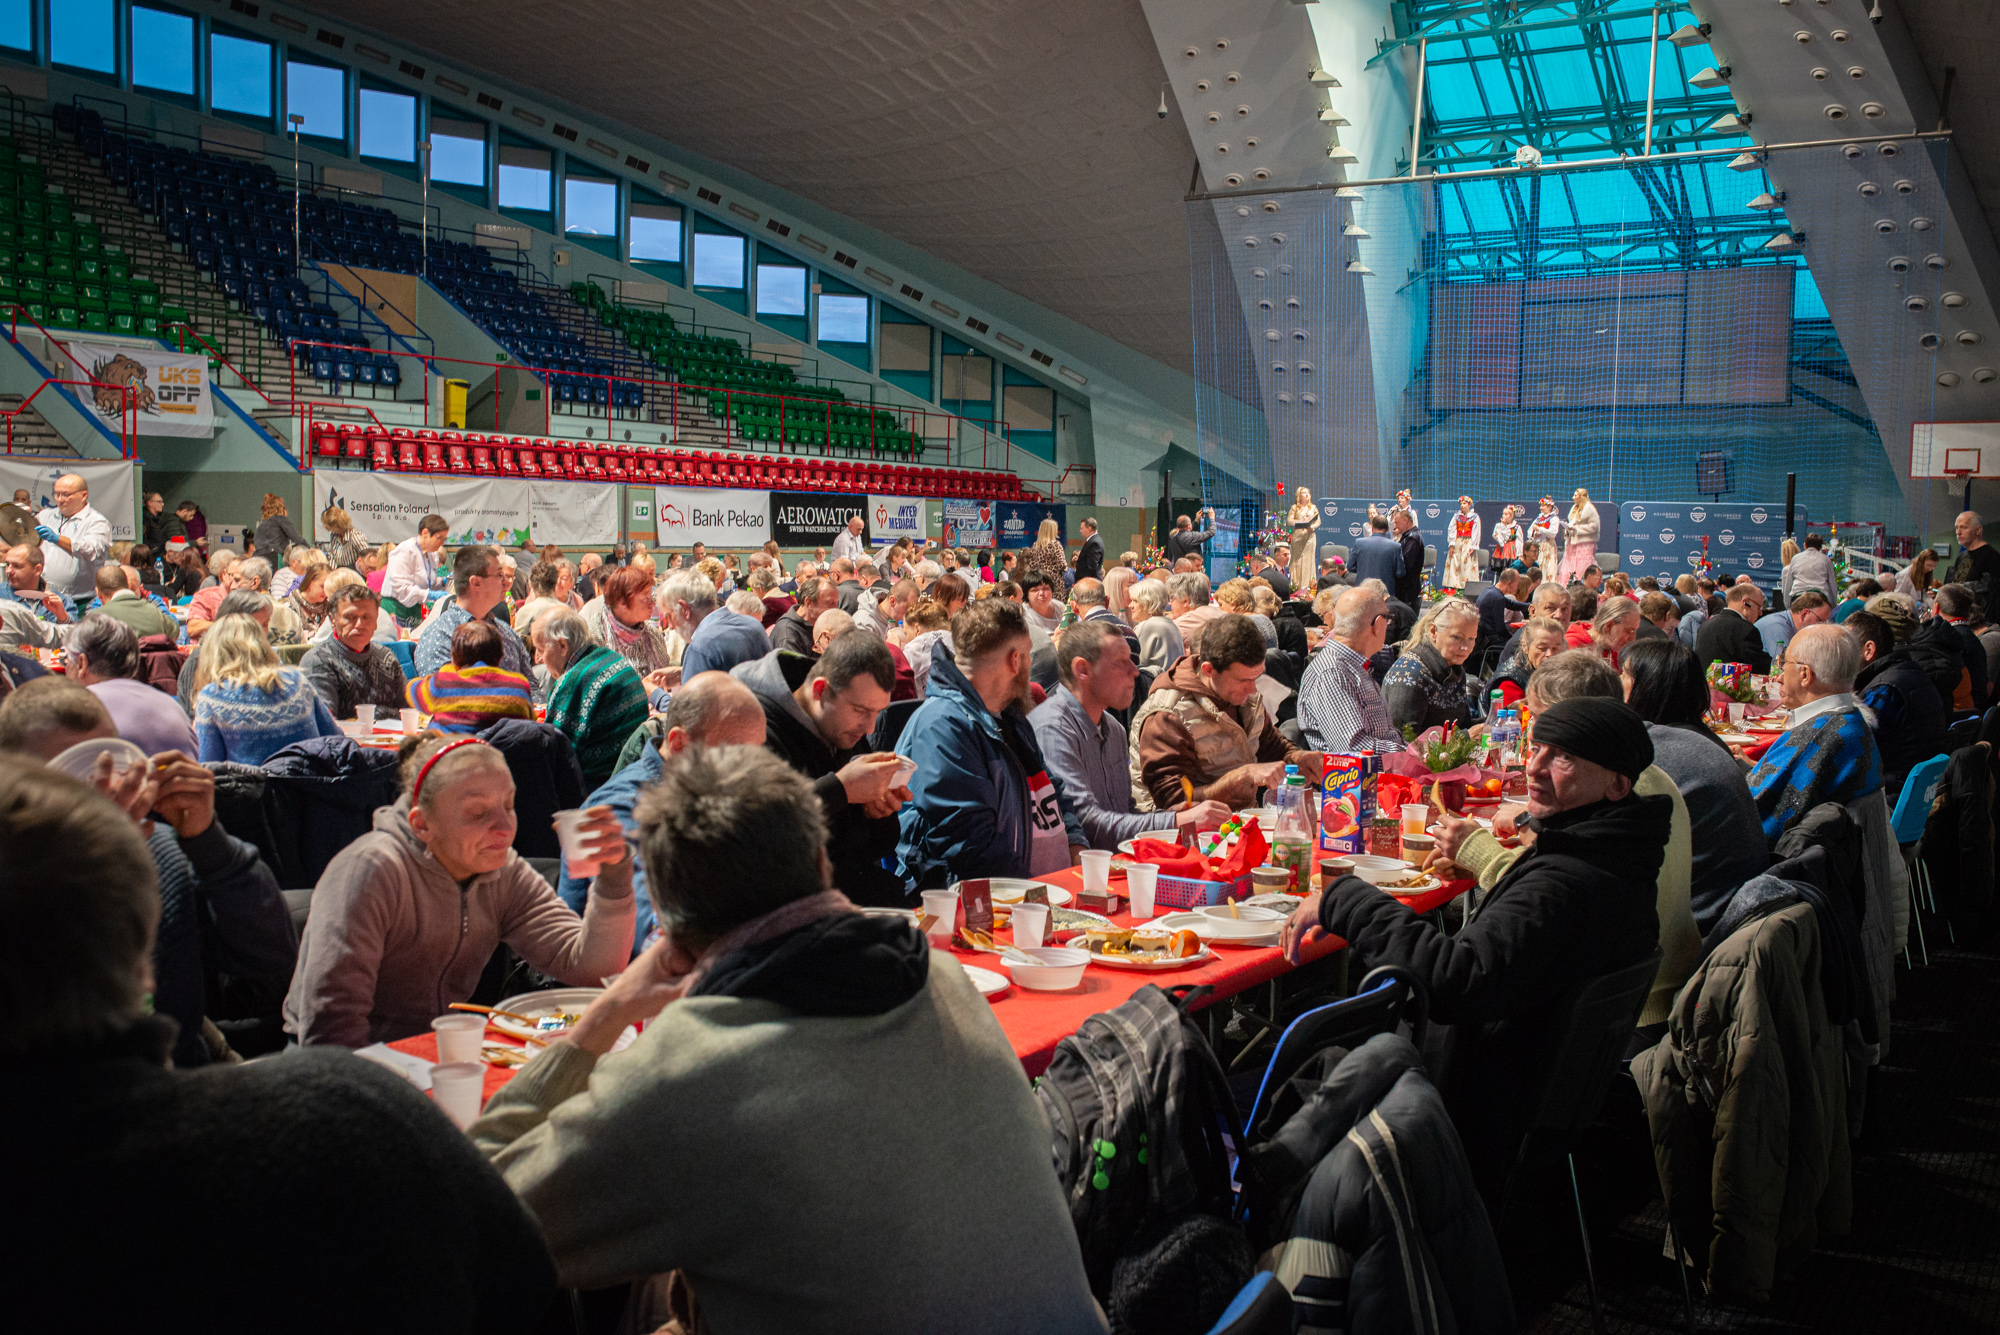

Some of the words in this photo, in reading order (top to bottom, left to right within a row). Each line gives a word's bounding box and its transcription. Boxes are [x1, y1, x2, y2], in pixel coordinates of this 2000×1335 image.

[158, 366, 202, 385] UKS
[158, 385, 201, 403] OPP
[350, 501, 396, 513] Sensation
[398, 503, 430, 515] Poland
[1120, 497, 1127, 506] D
[455, 508, 480, 517] produkty
[898, 505, 917, 518] INTER
[693, 509, 725, 527] Bank
[728, 509, 764, 528] Pekao
[889, 517, 917, 530] MEDICAL
[1326, 755, 1333, 766] 2
[1324, 767, 1359, 791] Caprio
